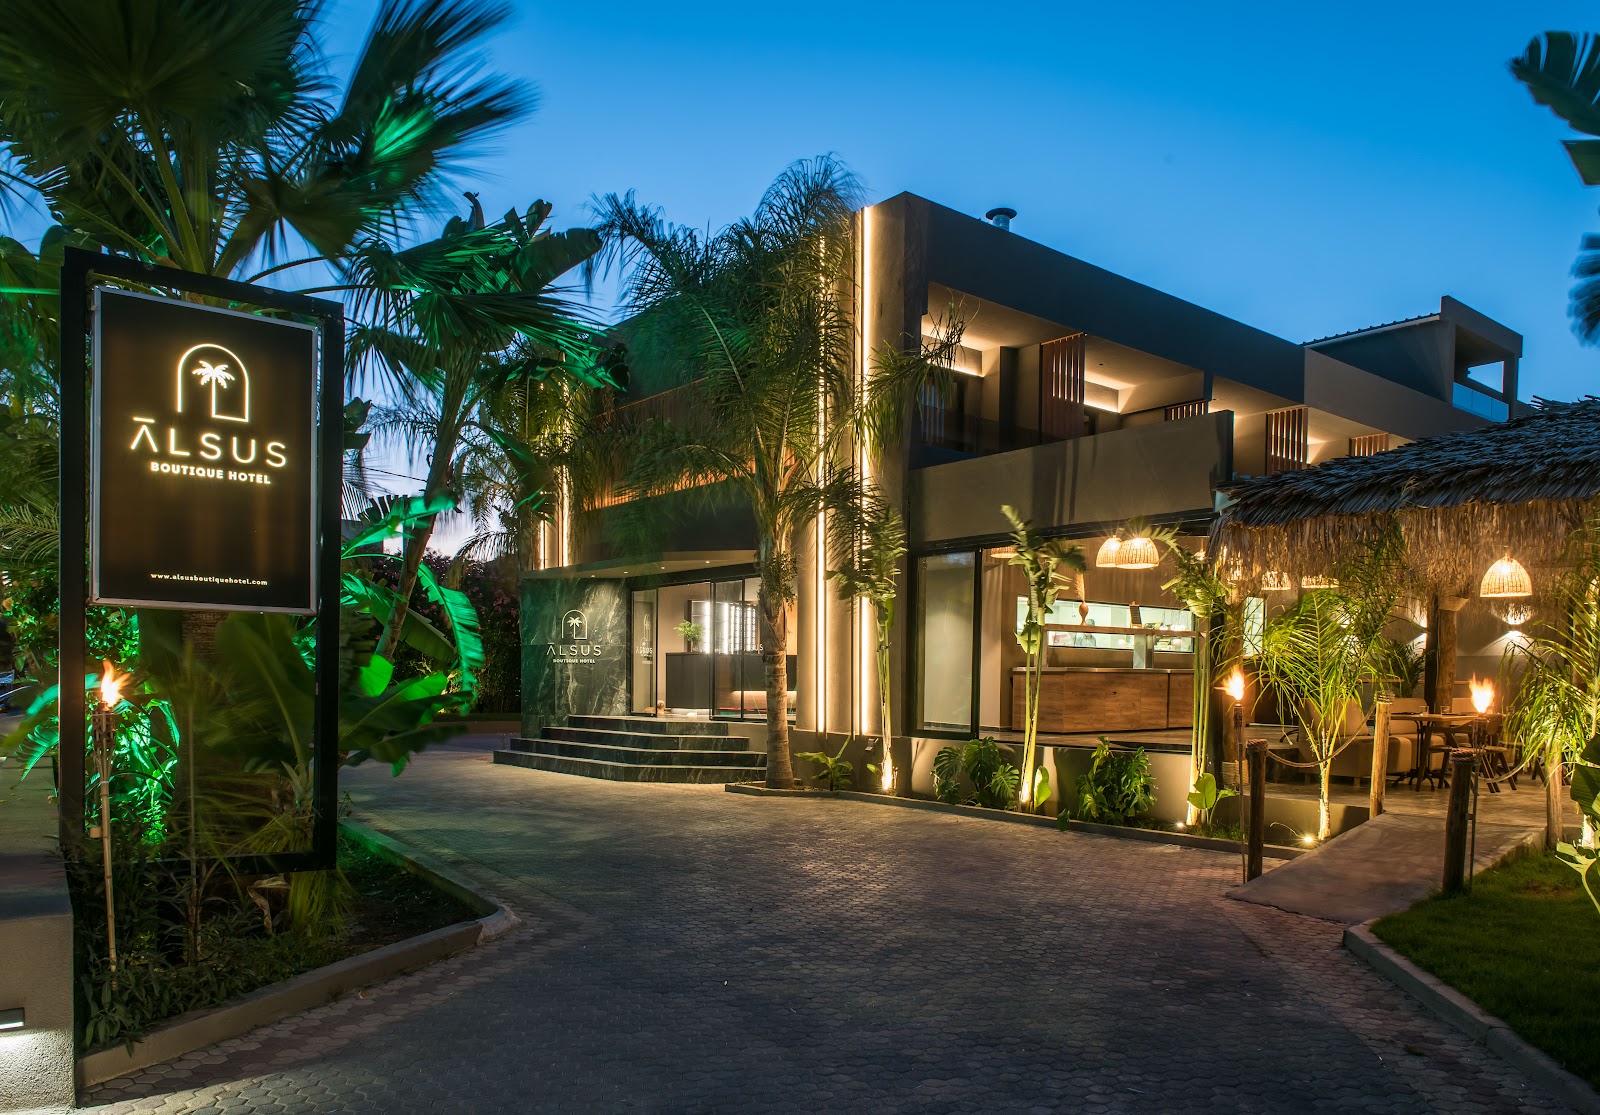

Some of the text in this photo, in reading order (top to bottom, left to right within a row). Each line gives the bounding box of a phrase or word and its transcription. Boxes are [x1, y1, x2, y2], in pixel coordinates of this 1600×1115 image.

[150, 461, 271, 484] BOUTIQUE HOTEL
[150, 573, 268, 586] www.alsusboutiquehotel.com
